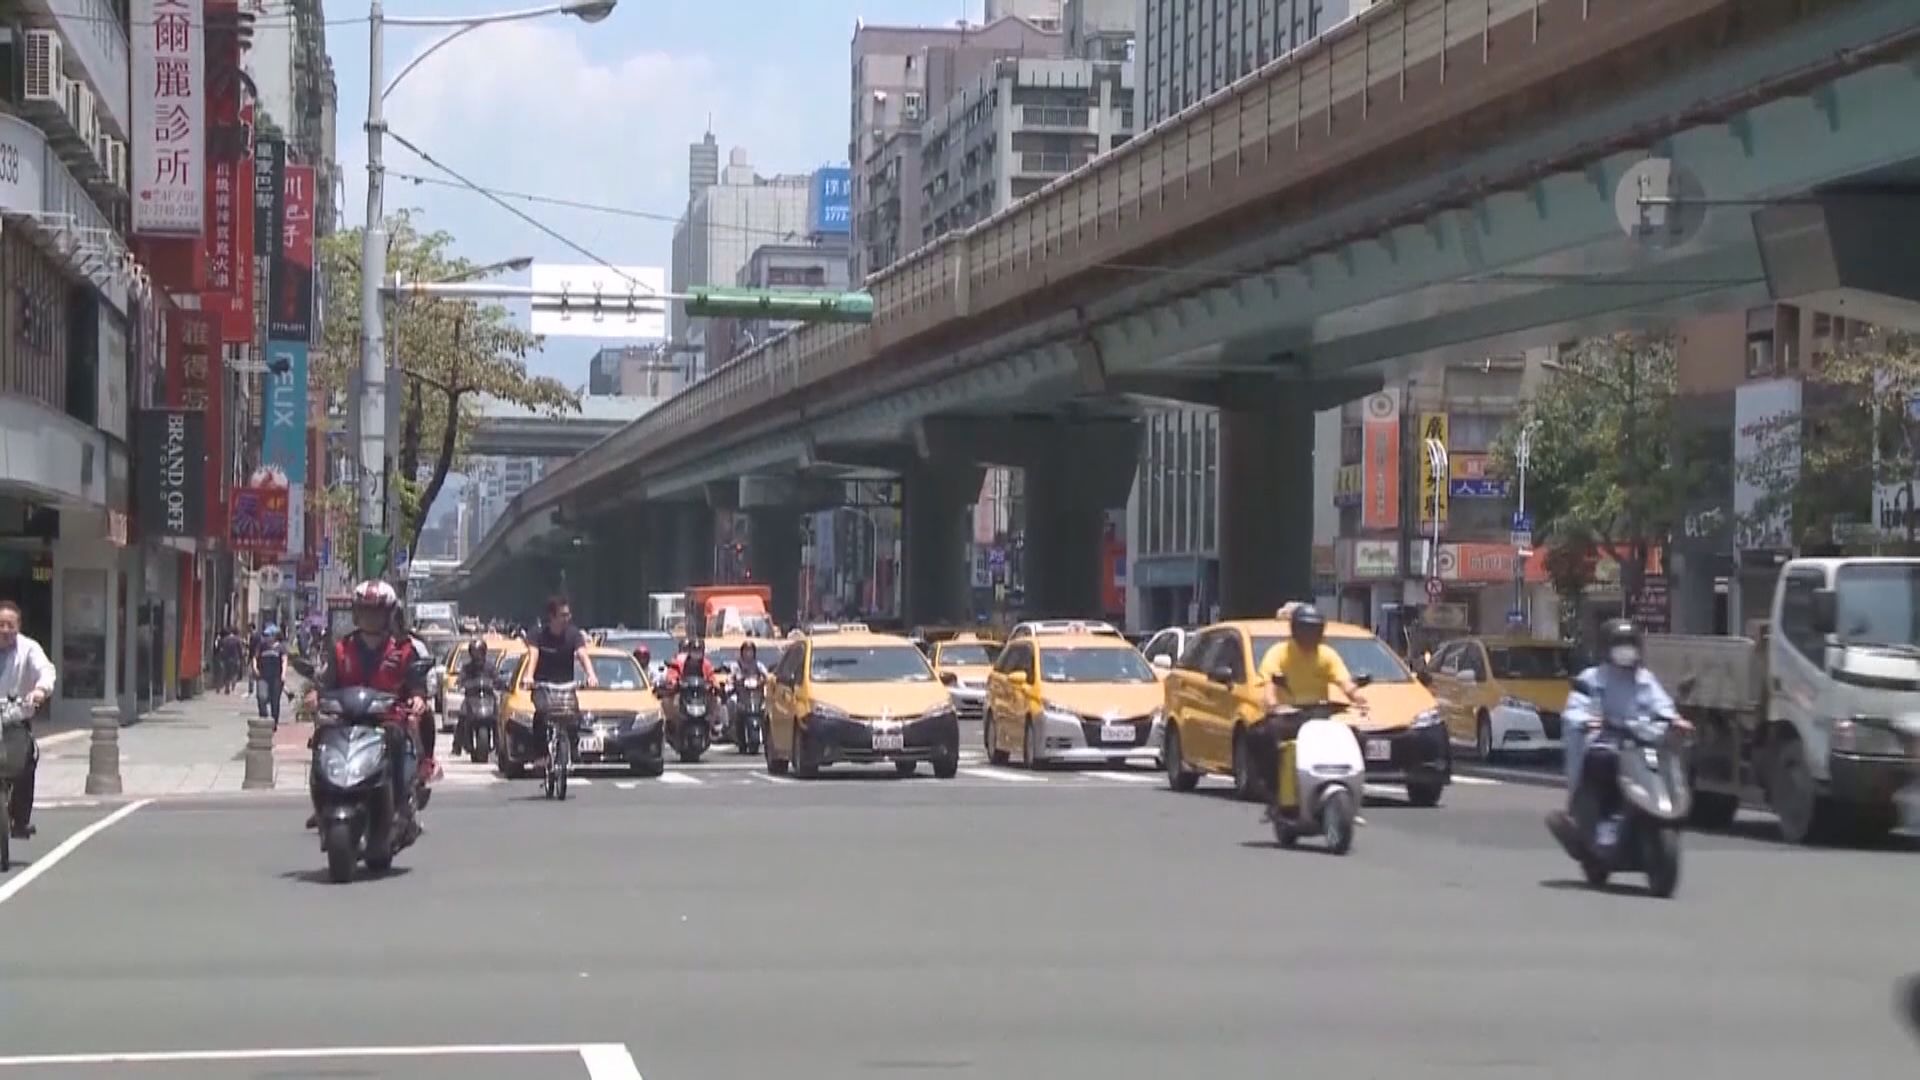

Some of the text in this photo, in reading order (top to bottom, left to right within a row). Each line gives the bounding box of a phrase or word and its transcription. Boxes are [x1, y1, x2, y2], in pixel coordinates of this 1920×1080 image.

[153, 0, 192, 186] 爾麗診所
[168, 413, 184, 533] BRAND OFF
